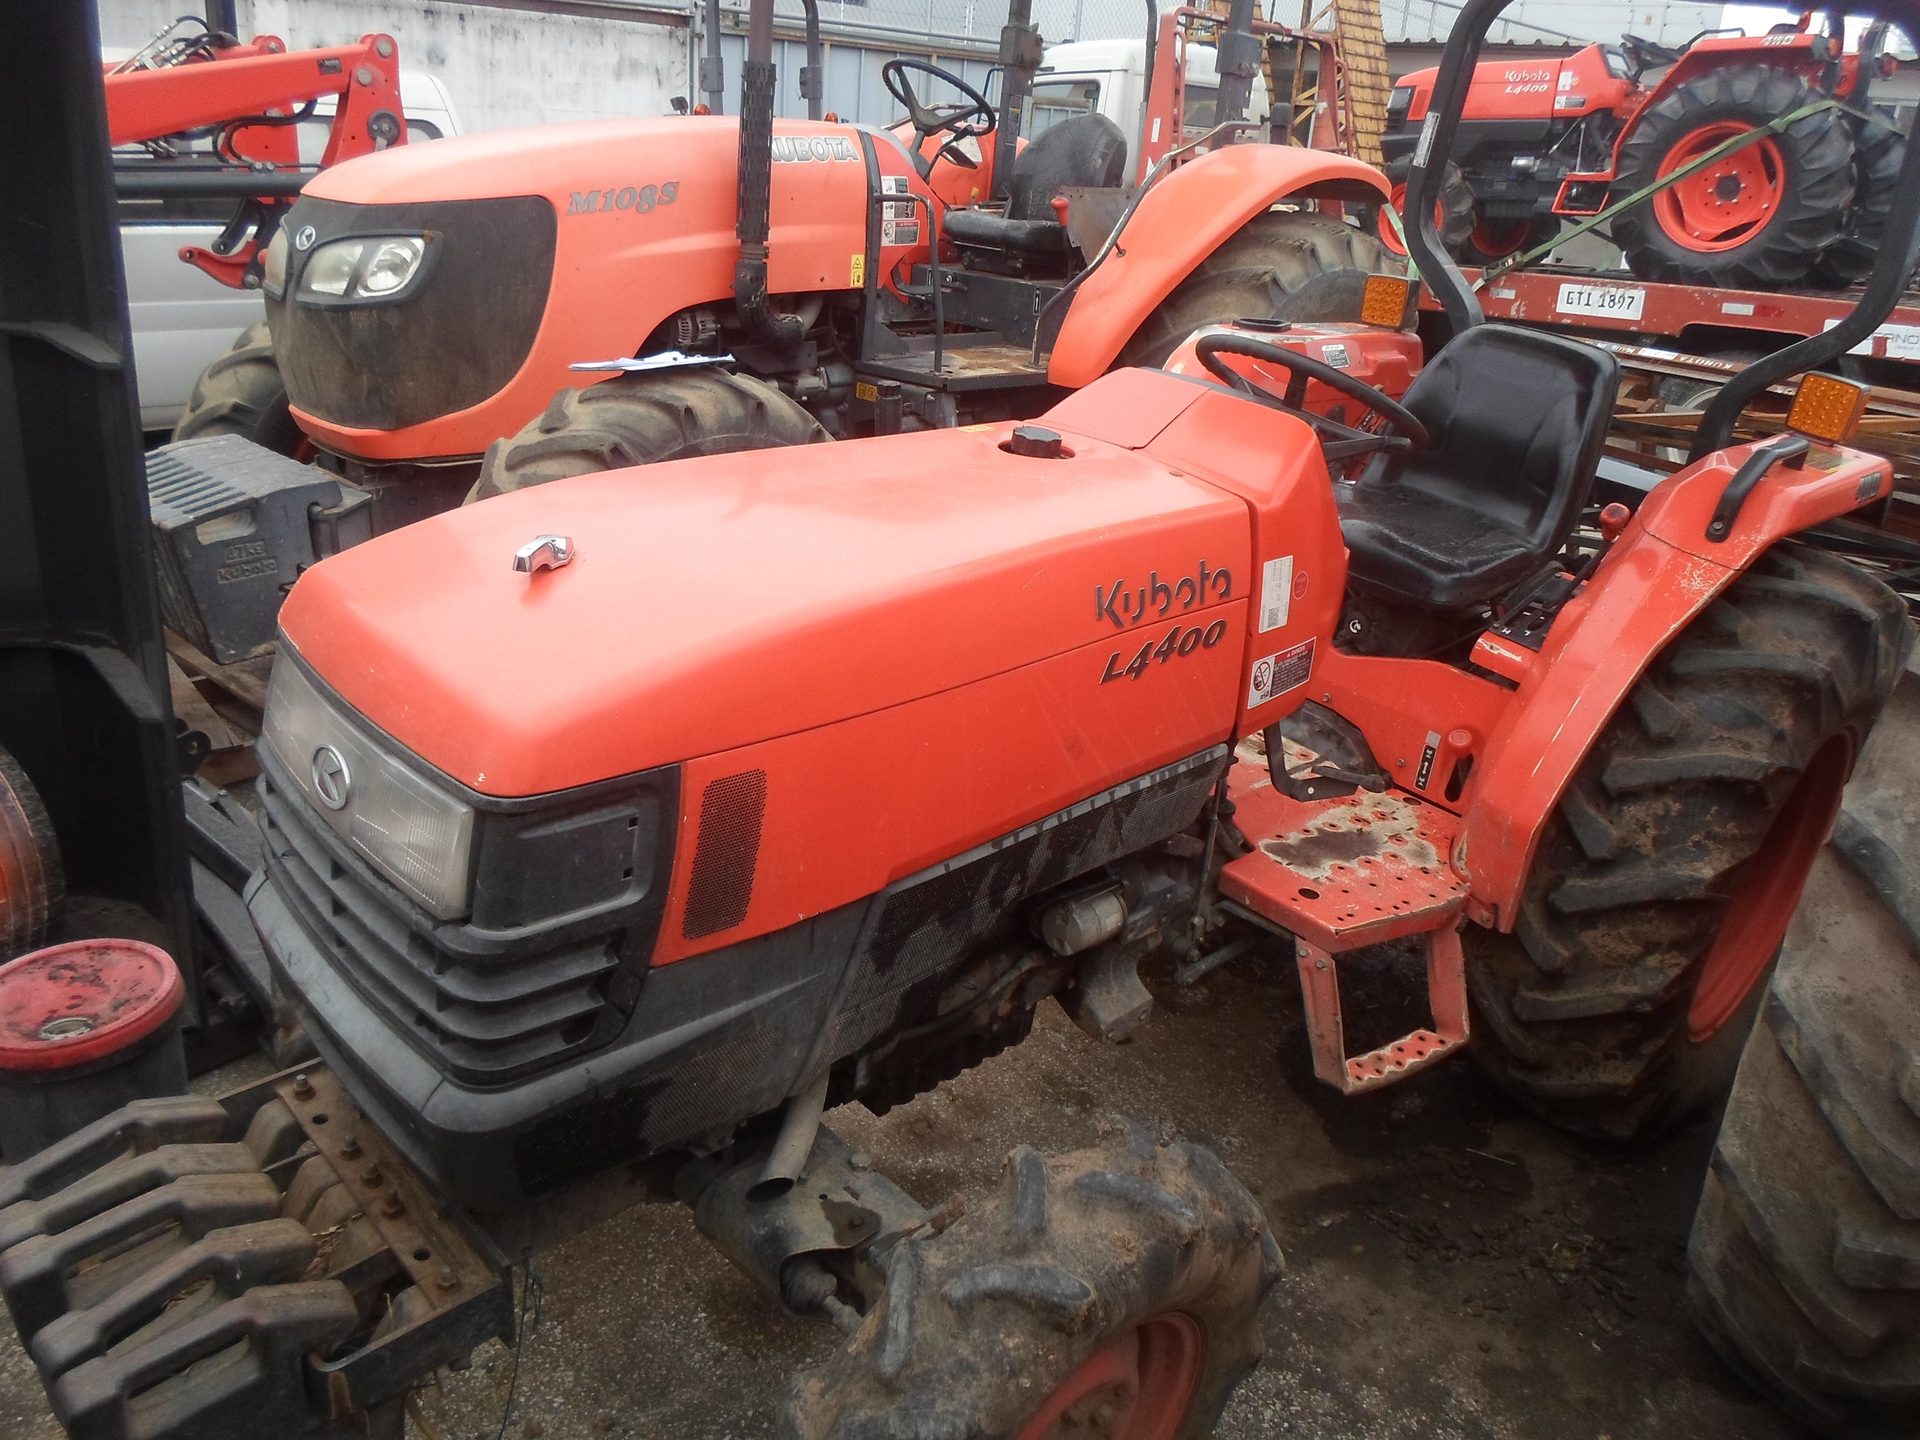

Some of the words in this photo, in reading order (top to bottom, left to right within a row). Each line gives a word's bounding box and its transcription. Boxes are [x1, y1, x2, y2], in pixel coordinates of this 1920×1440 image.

[1504, 70, 1551, 82] Kubota
[1505, 84, 1550, 95] L4400
[565, 181, 680, 215] M108S
[1095, 559, 1233, 629] Kubota
[1099, 618, 1228, 685] L4400
